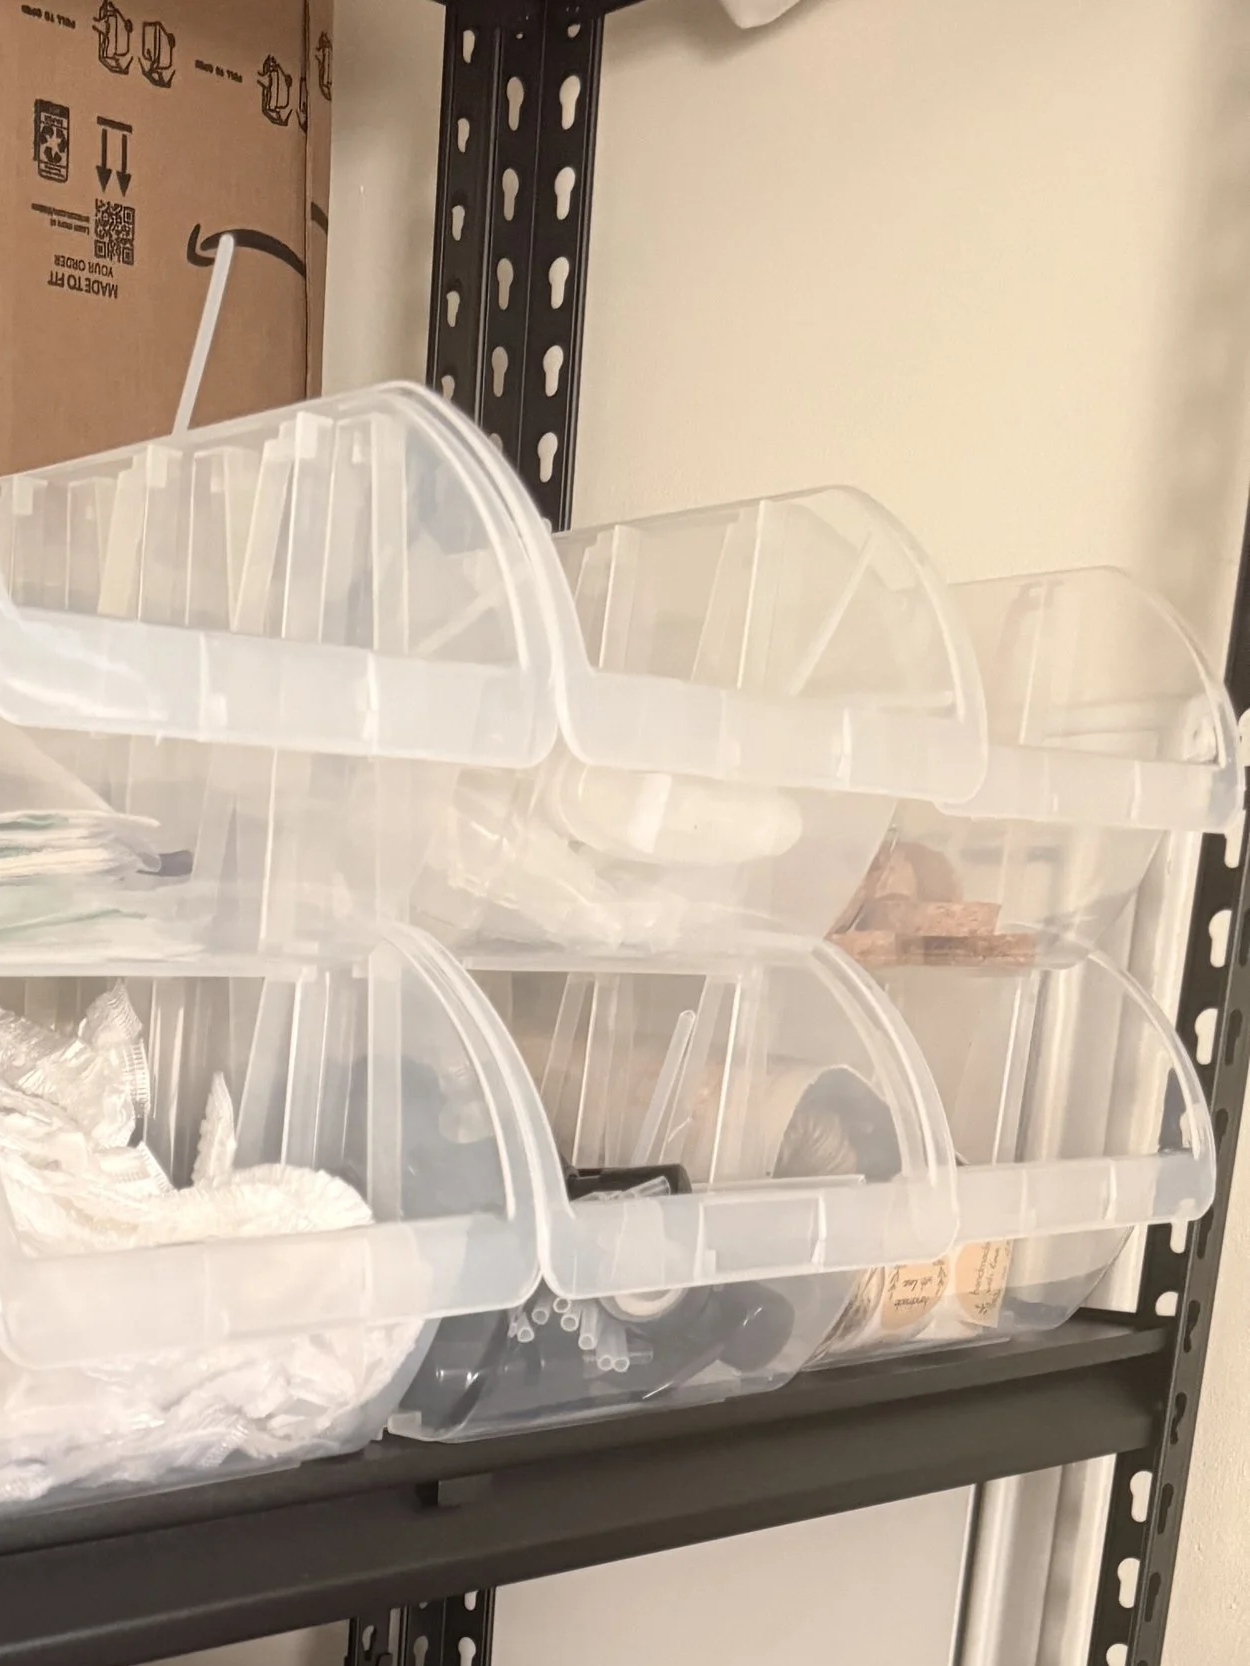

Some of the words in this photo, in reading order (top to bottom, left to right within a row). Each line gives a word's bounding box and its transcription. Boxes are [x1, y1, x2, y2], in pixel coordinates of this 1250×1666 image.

[54, 254, 86, 272] ORDER
[88, 261, 114, 278] YOUR
[47, 270, 65, 288] FIT
[67, 274, 83, 292] TO
[85, 277, 118, 299] MADE
